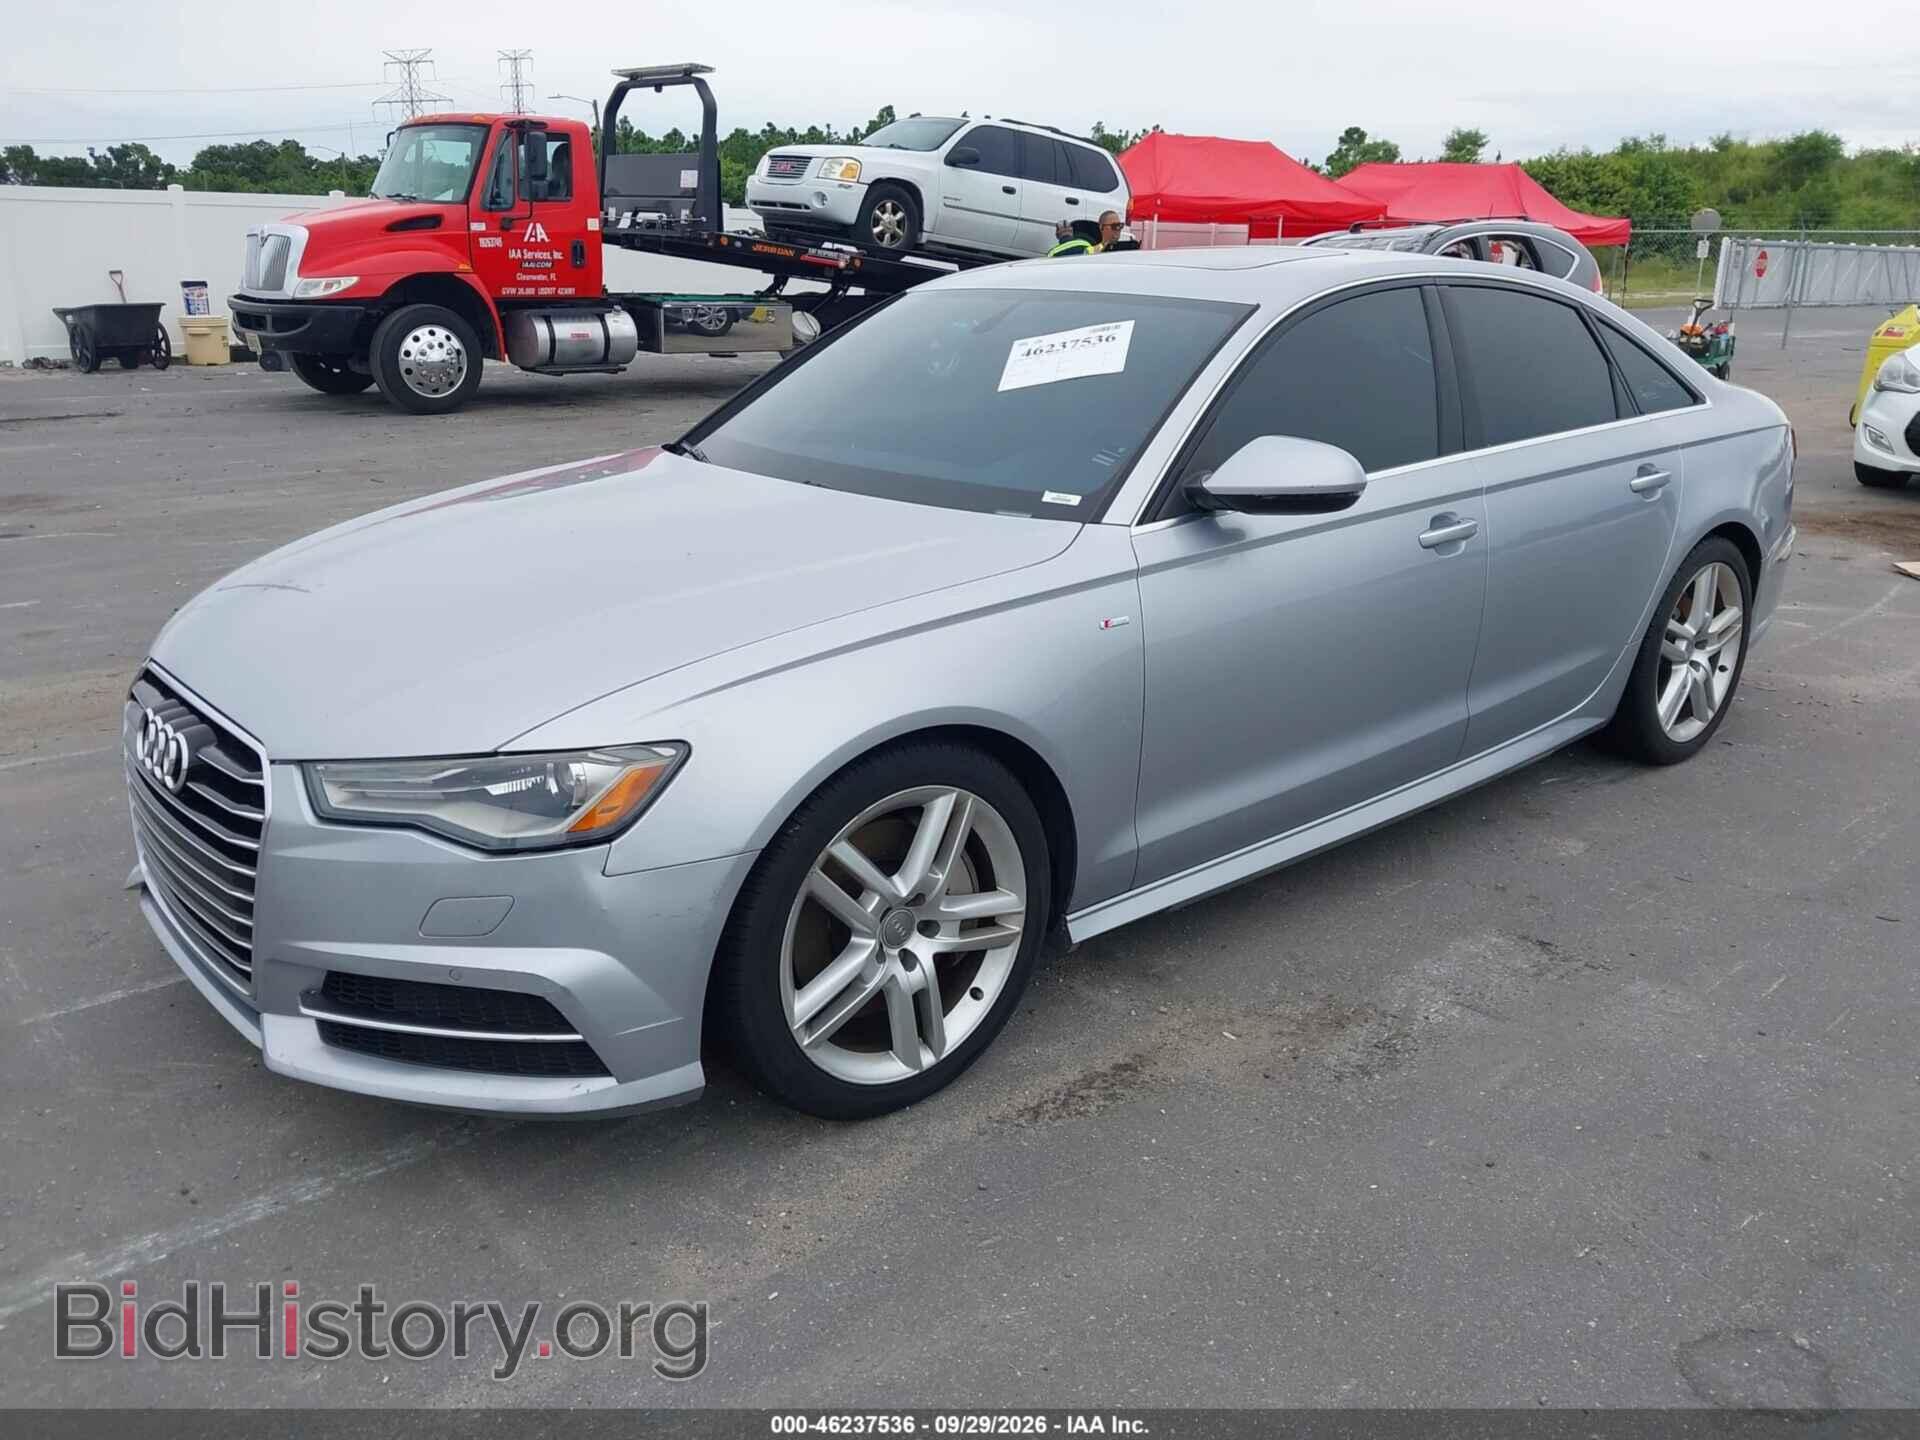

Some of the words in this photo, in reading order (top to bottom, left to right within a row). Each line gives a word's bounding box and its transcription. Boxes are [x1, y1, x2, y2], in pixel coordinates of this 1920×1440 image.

[509, 249, 521, 259] IAA
[523, 249, 553, 260] Services,
[553, 250, 564, 259] Inc.
[1021, 334, 1116, 357] 46237536
